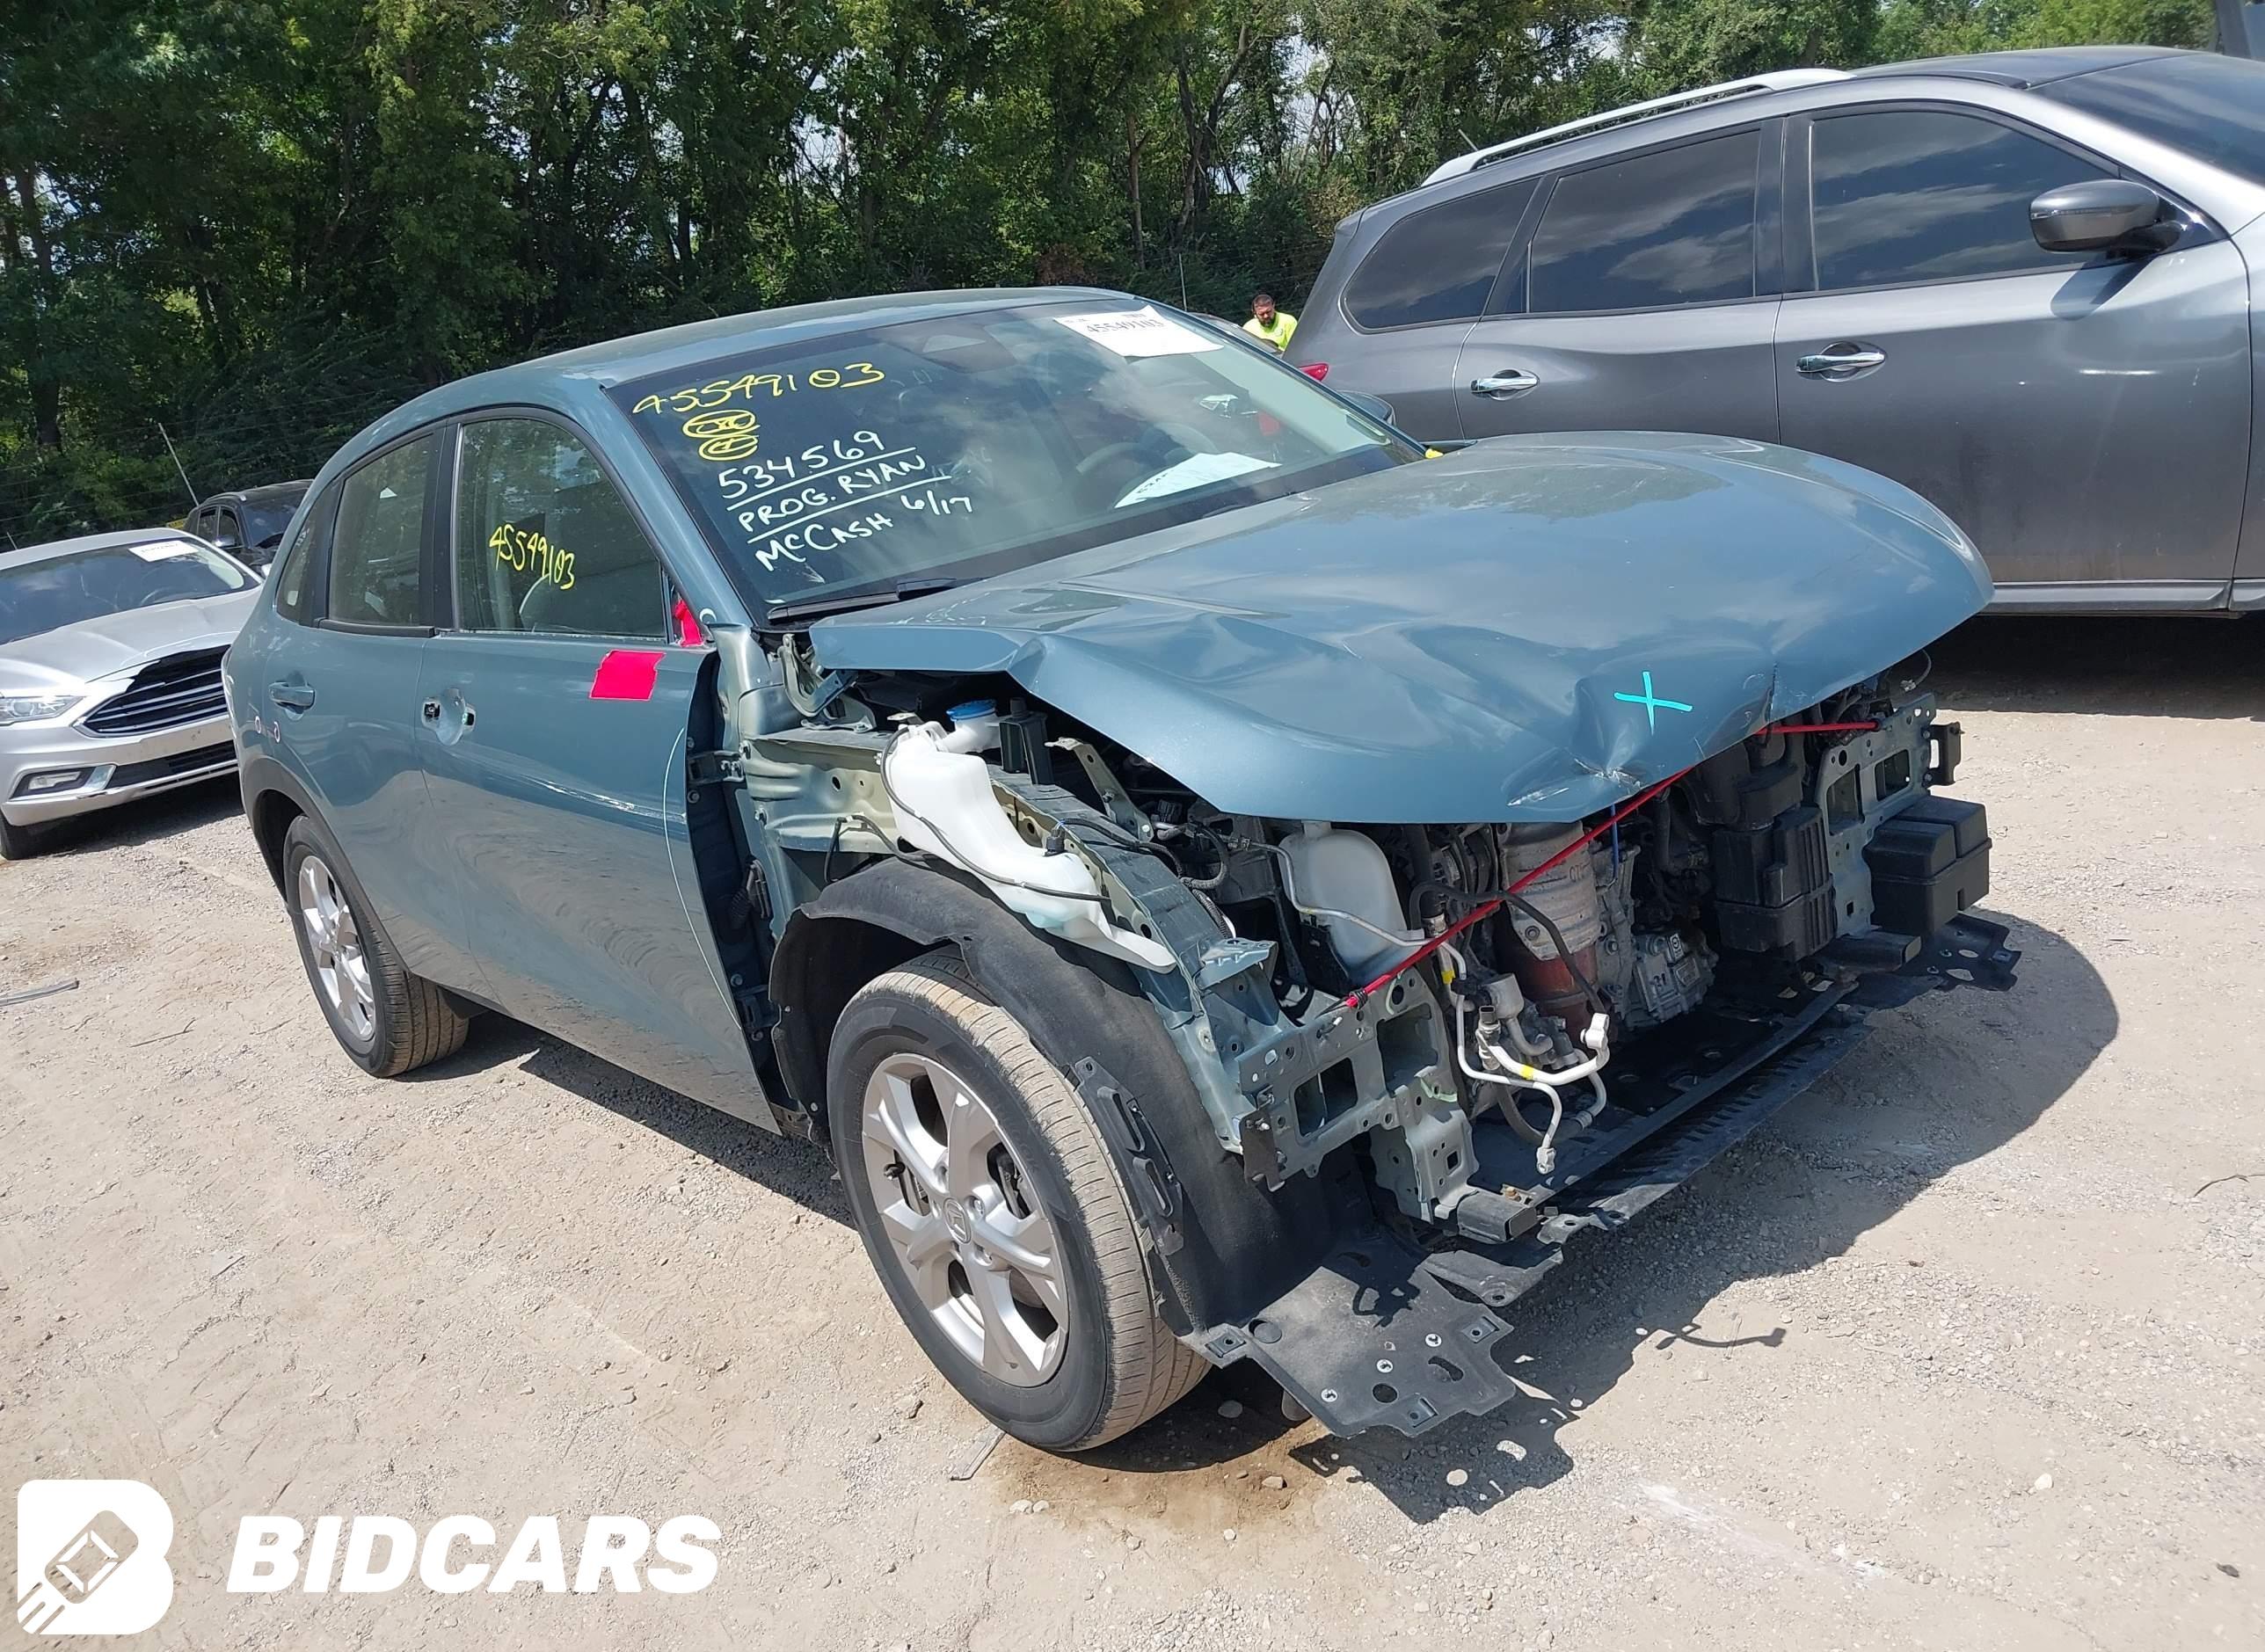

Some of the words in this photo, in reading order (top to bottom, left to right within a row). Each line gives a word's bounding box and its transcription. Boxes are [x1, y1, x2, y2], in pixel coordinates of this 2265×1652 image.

[739, 487, 837, 533] PROG.
[840, 453, 927, 495] RYAN
[901, 489, 972, 516] 6/17
[489, 523, 575, 590] 45549103
